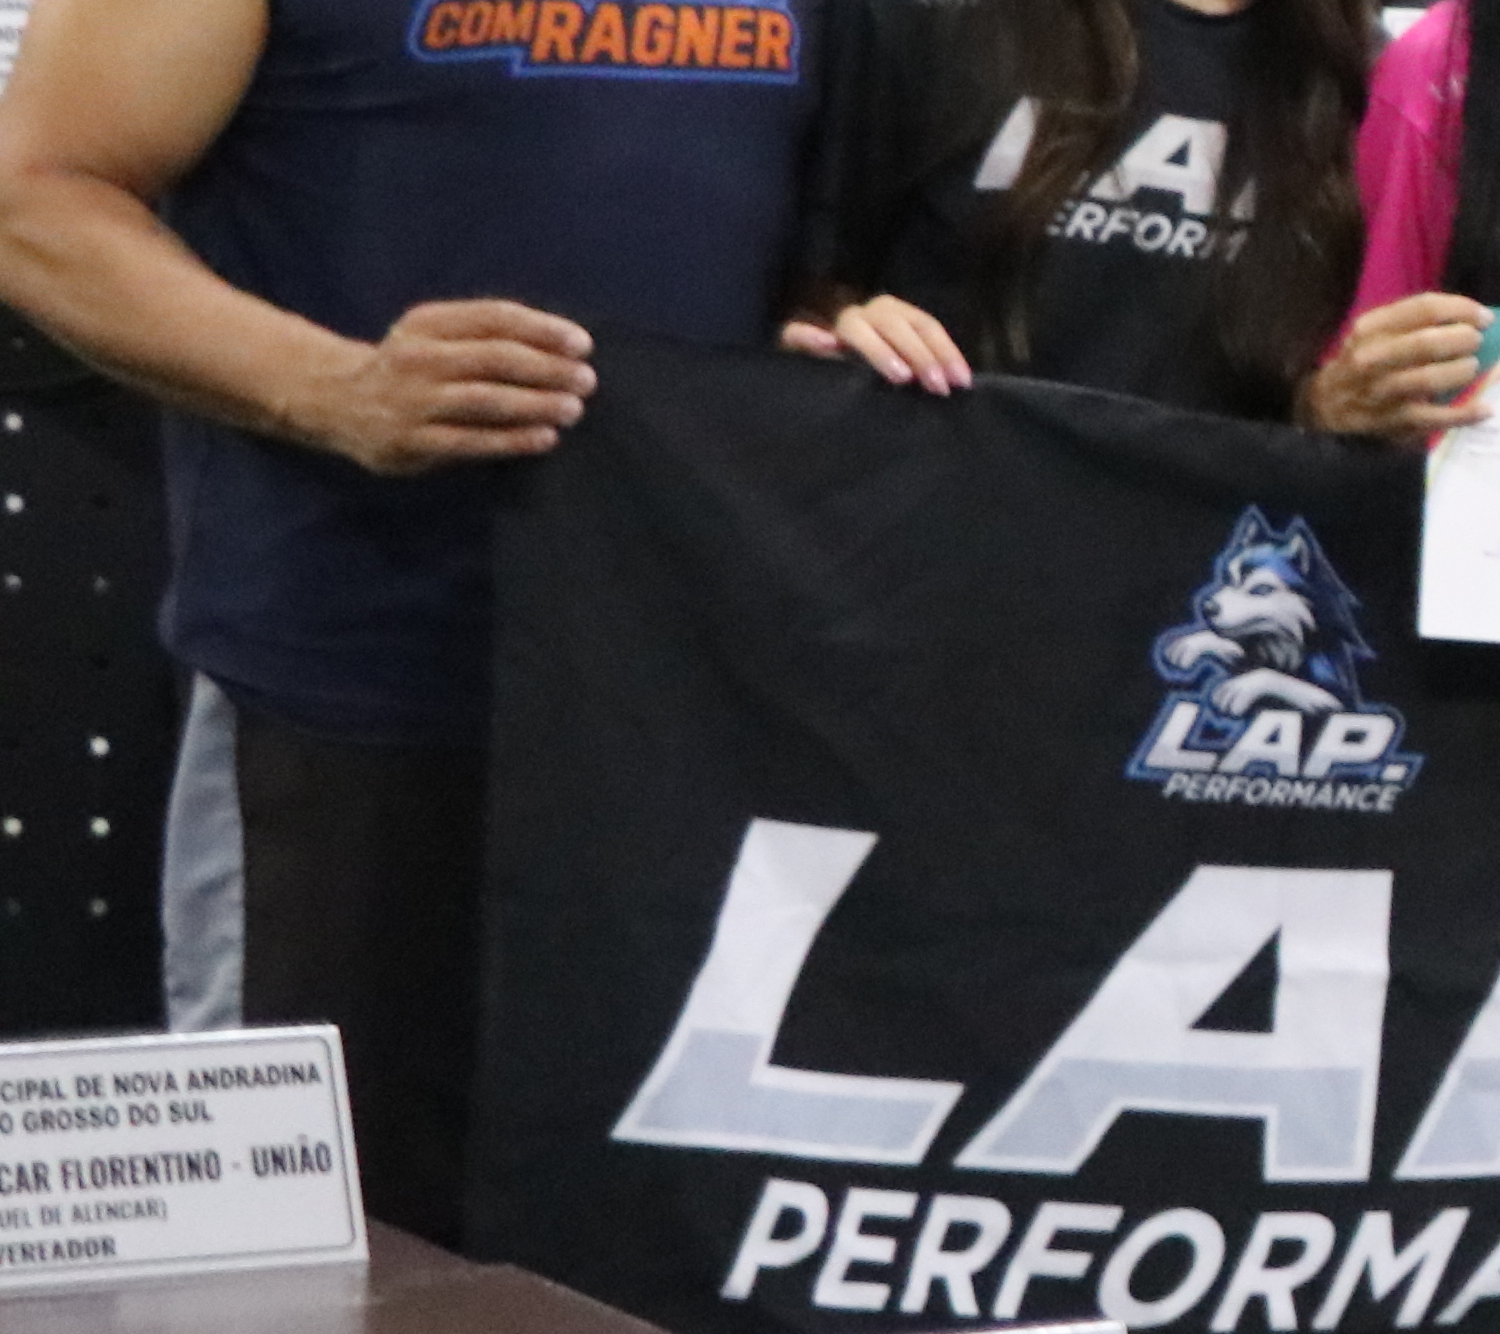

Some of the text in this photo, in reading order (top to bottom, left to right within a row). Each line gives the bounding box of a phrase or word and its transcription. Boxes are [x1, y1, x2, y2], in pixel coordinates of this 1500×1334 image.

[1145, 700, 1409, 782] LAP.
[1162, 771, 1403, 813] PERFORMANCE
[75, 1074, 104, 1099] DE
[113, 1070, 178, 1097] NOVA
[187, 1062, 322, 1091] ANDRADINA
[23, 1105, 120, 1133] GROSSO
[128, 1101, 162, 1128] DO
[169, 1098, 214, 1124] SUL
[60, 1149, 222, 1193] FLORENTINO
[252, 1133, 332, 1178] UNIÃO
